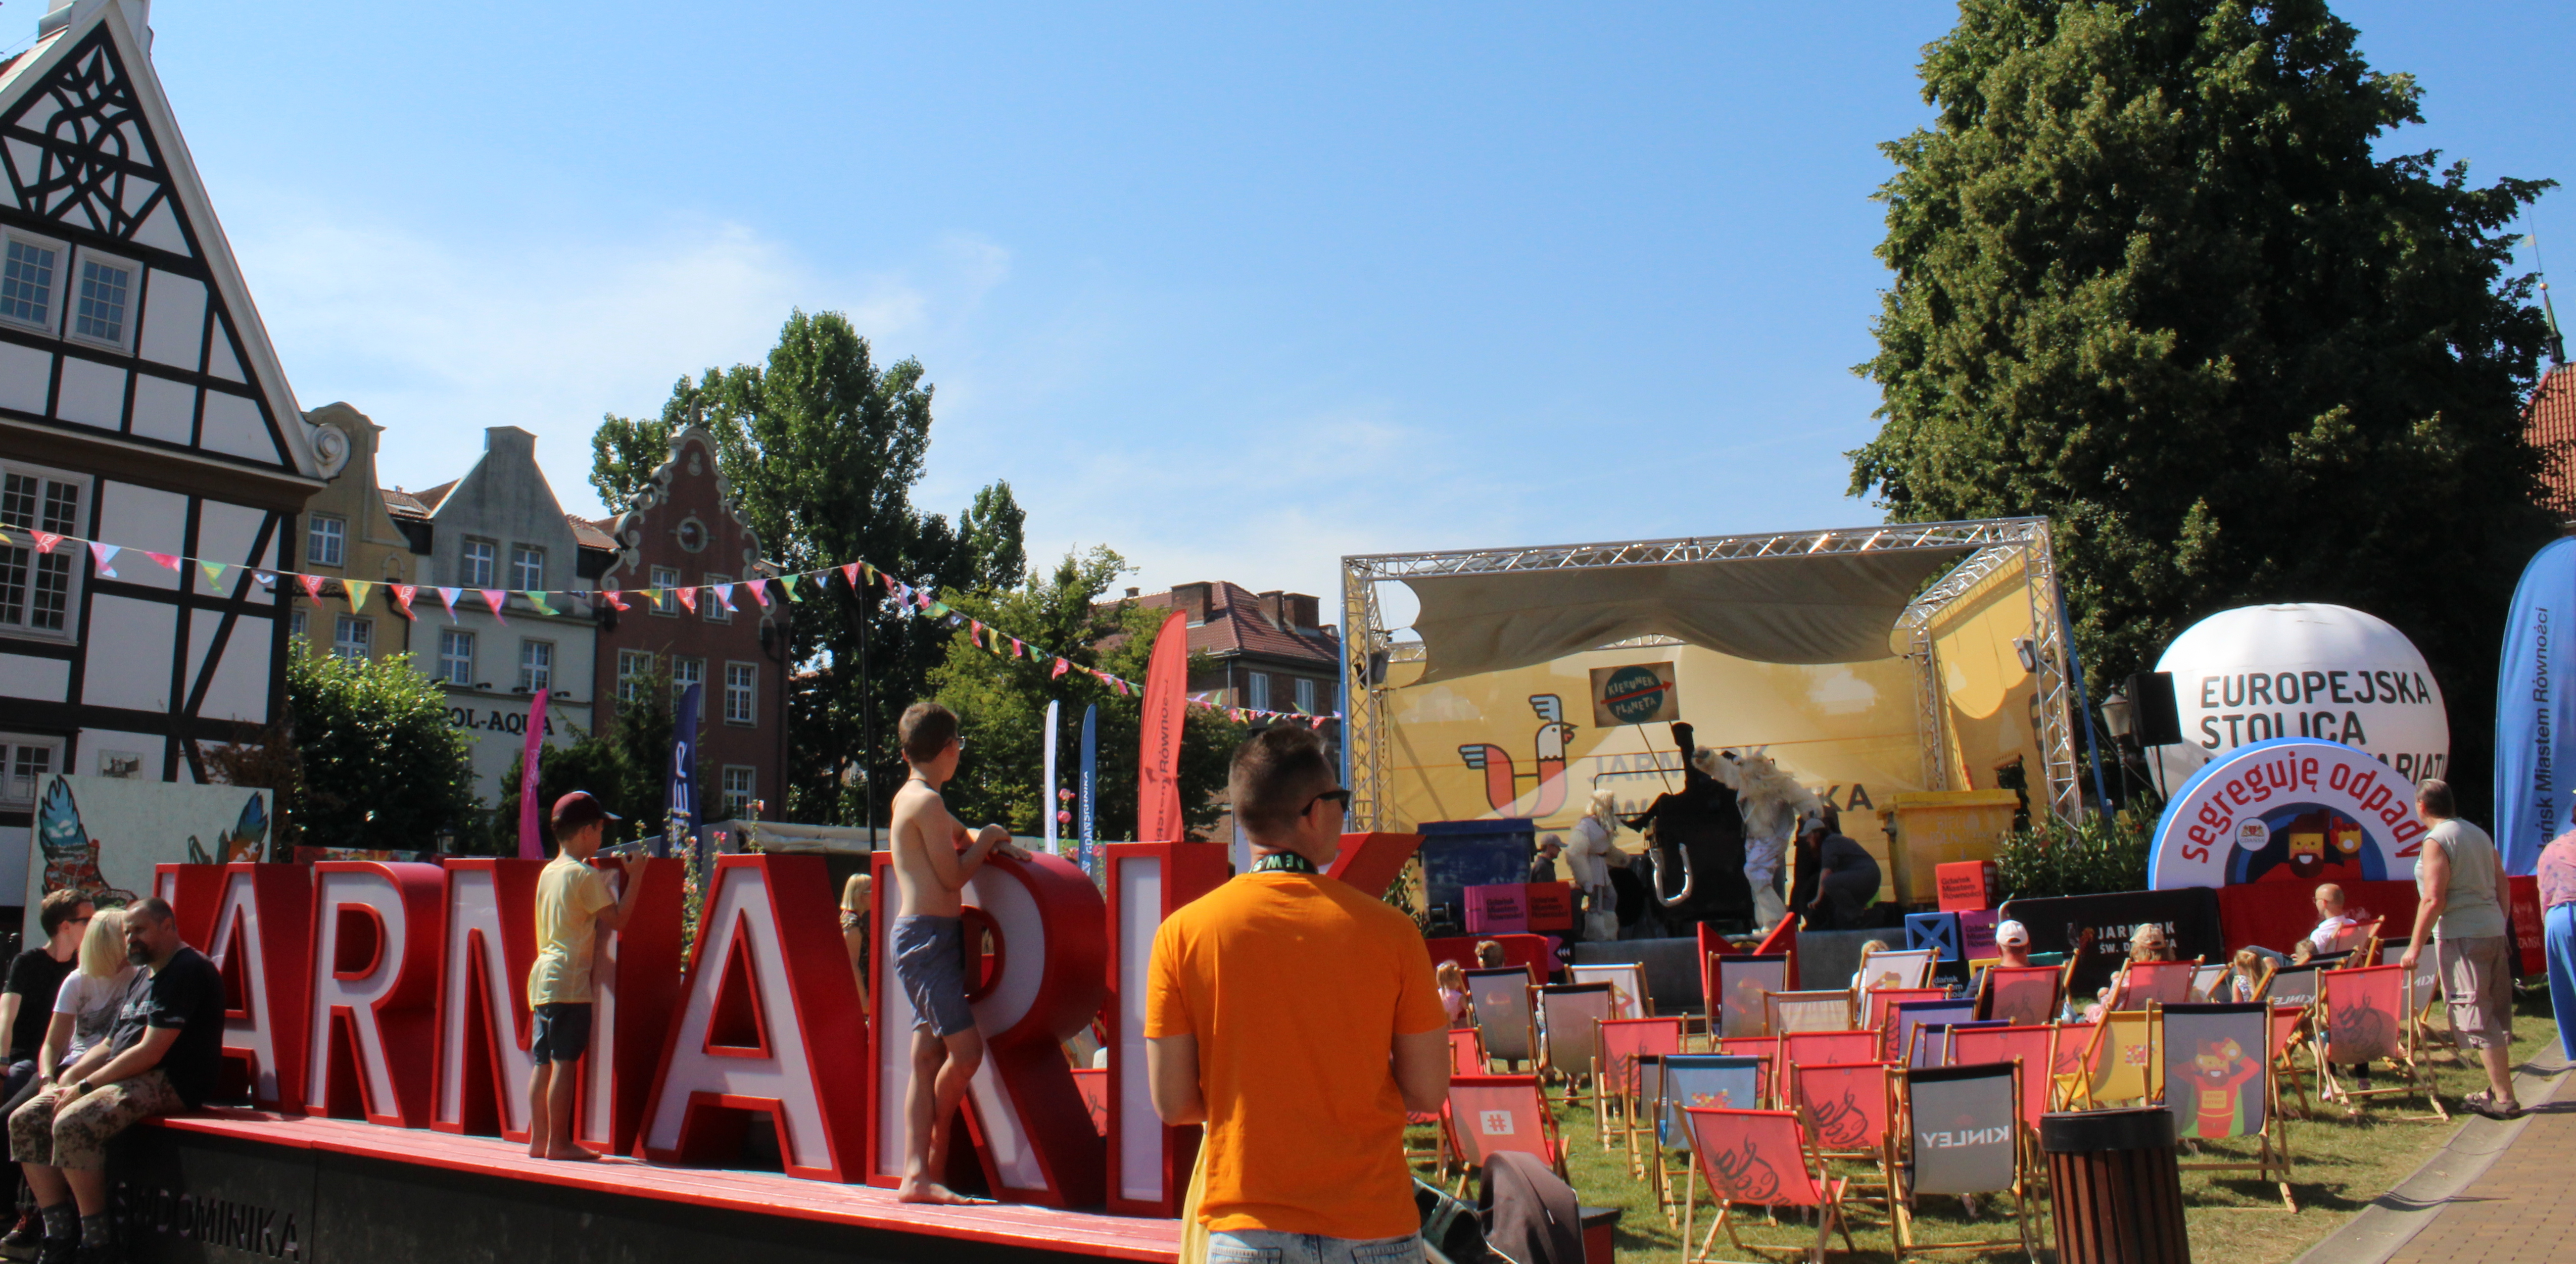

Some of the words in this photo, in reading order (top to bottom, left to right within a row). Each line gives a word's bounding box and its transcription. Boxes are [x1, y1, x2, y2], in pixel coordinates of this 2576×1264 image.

[2533, 607, 2549, 703] Równości
[1608, 676, 1655, 696] KIERUNEK
[2201, 670, 2431, 708] EUROPEJSKA
[1615, 697, 1657, 716] PLANETA
[2200, 710, 2366, 749] STOLICA
[2534, 707, 2552, 792] Miastem
[2181, 751, 2319, 864] segreguję
[1941, 876, 1971, 884] Gdańsk
[1942, 884, 1976, 892] Miastem
[1943, 890, 1982, 900] Równości
